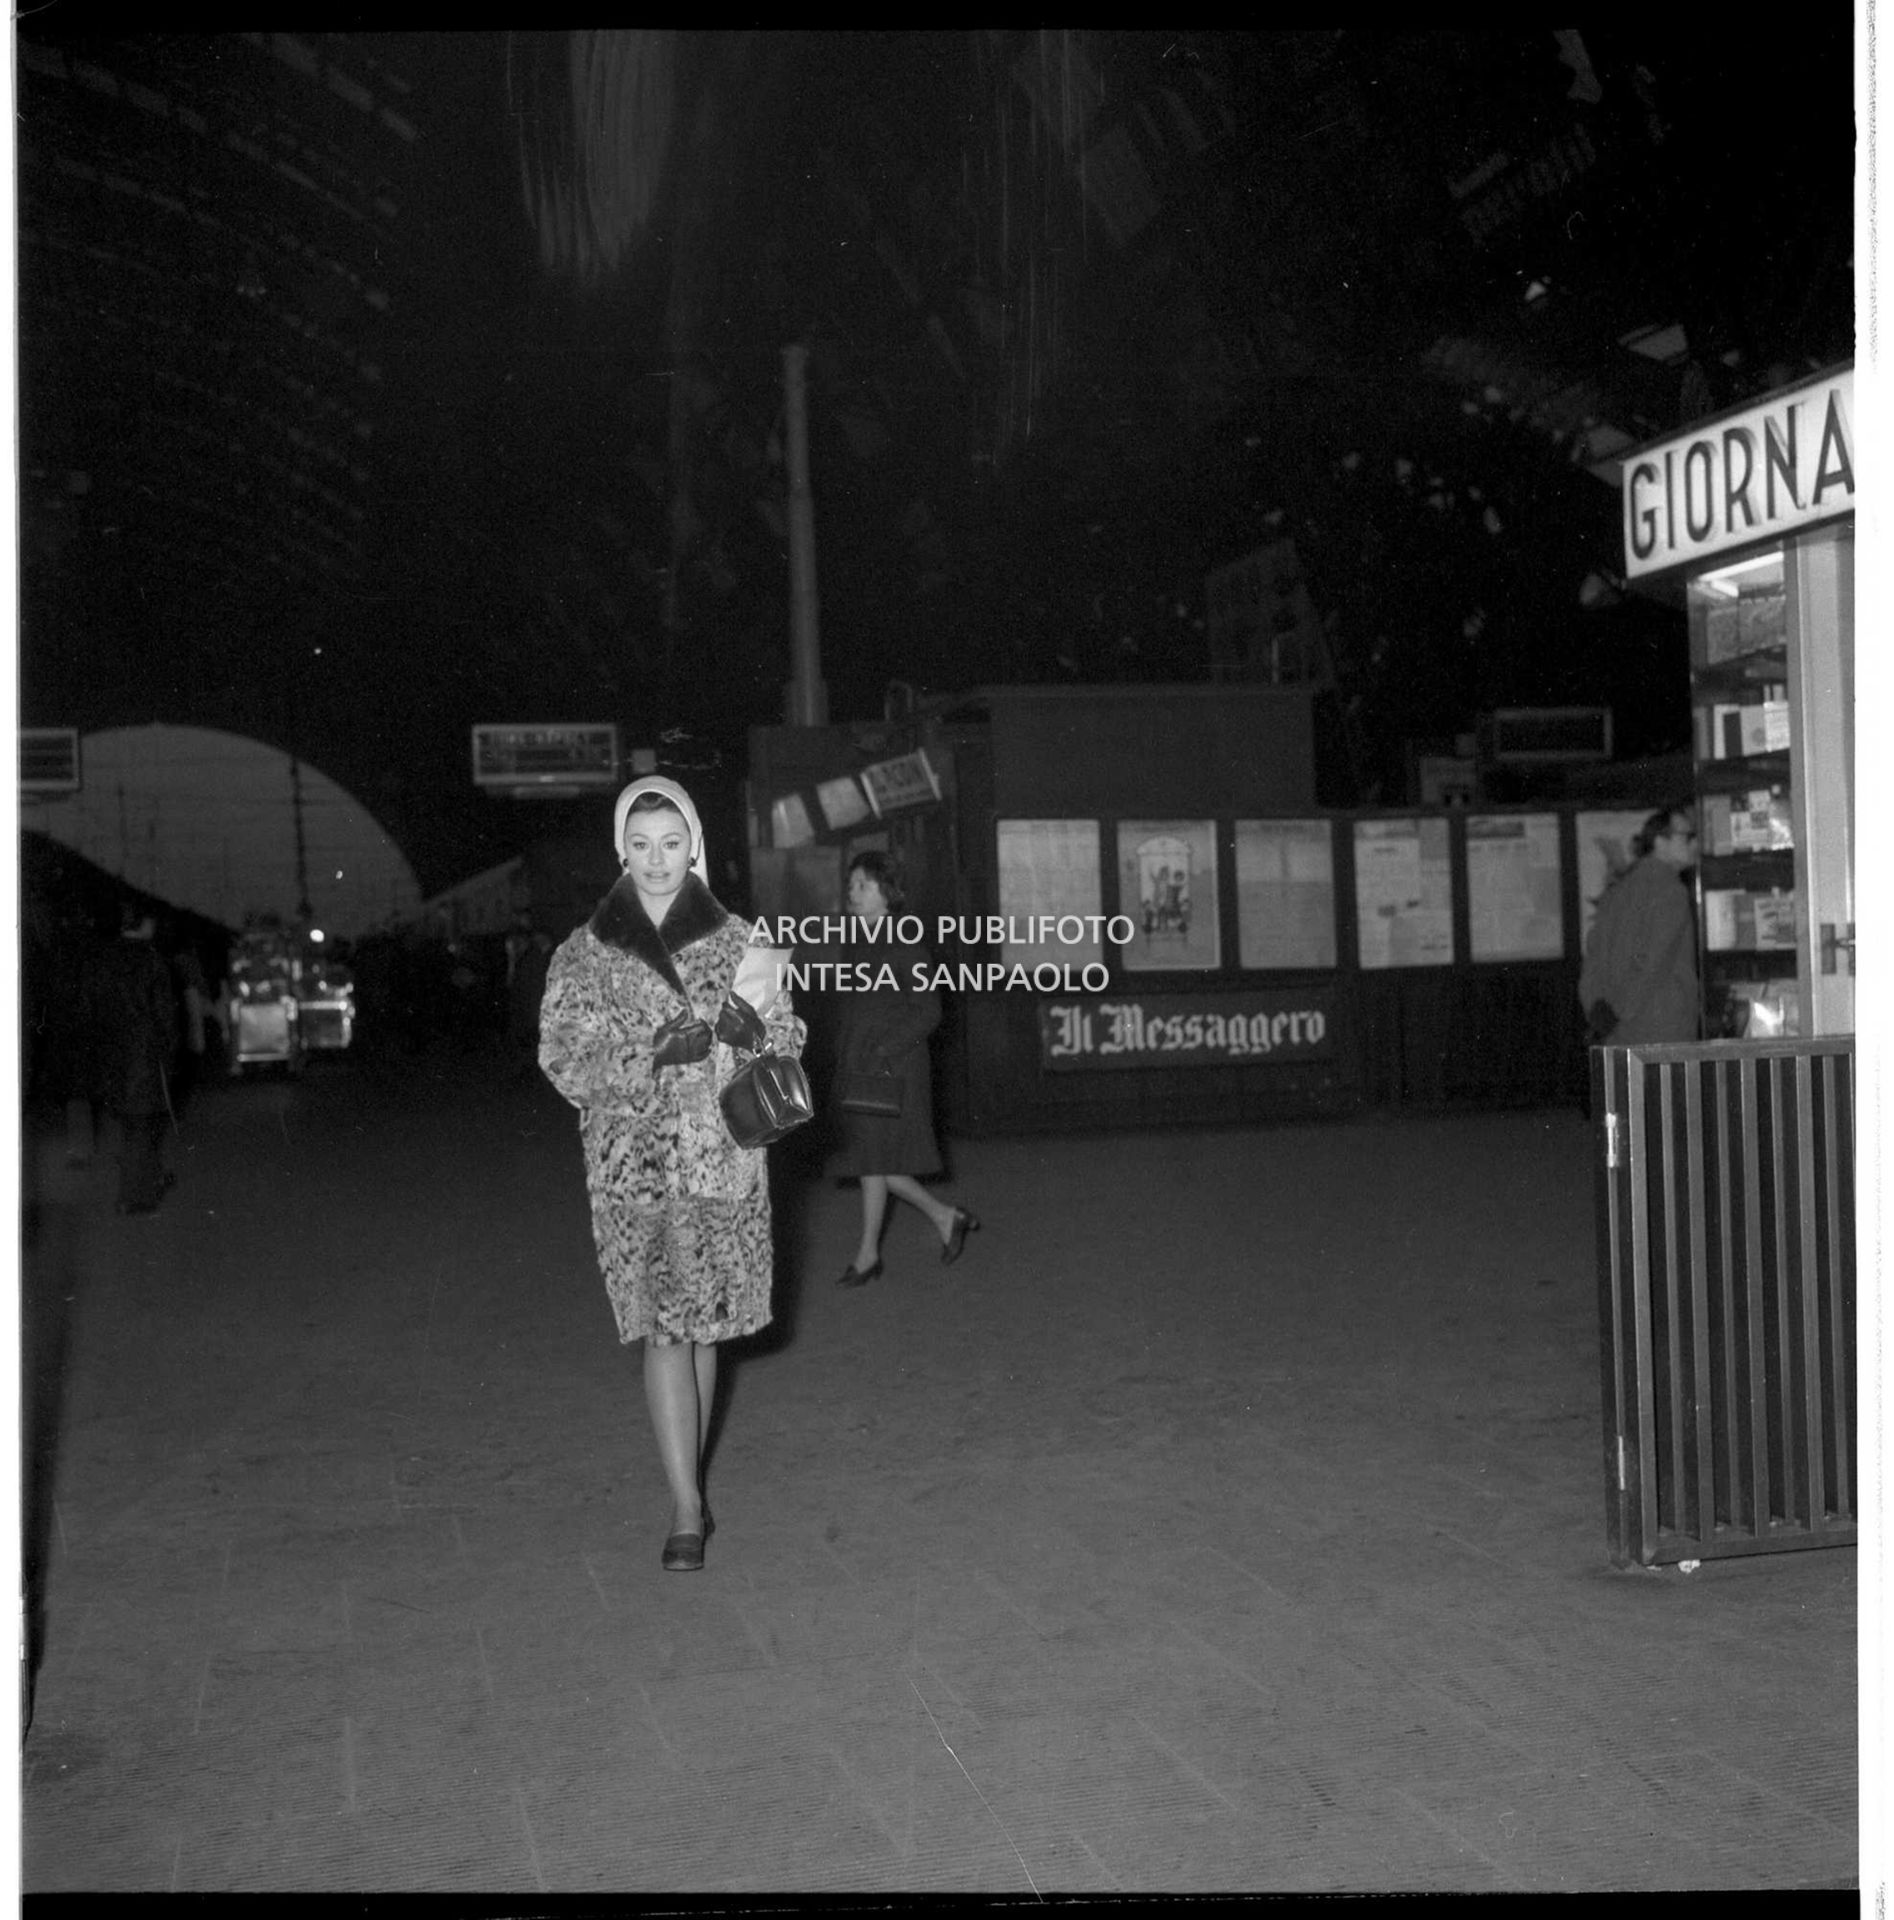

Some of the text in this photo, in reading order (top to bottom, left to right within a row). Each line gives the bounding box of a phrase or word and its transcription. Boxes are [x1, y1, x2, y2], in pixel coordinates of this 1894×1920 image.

[1630, 388, 1854, 561] GIORNA
[1049, 1003, 1327, 1057] Il Messaggero
